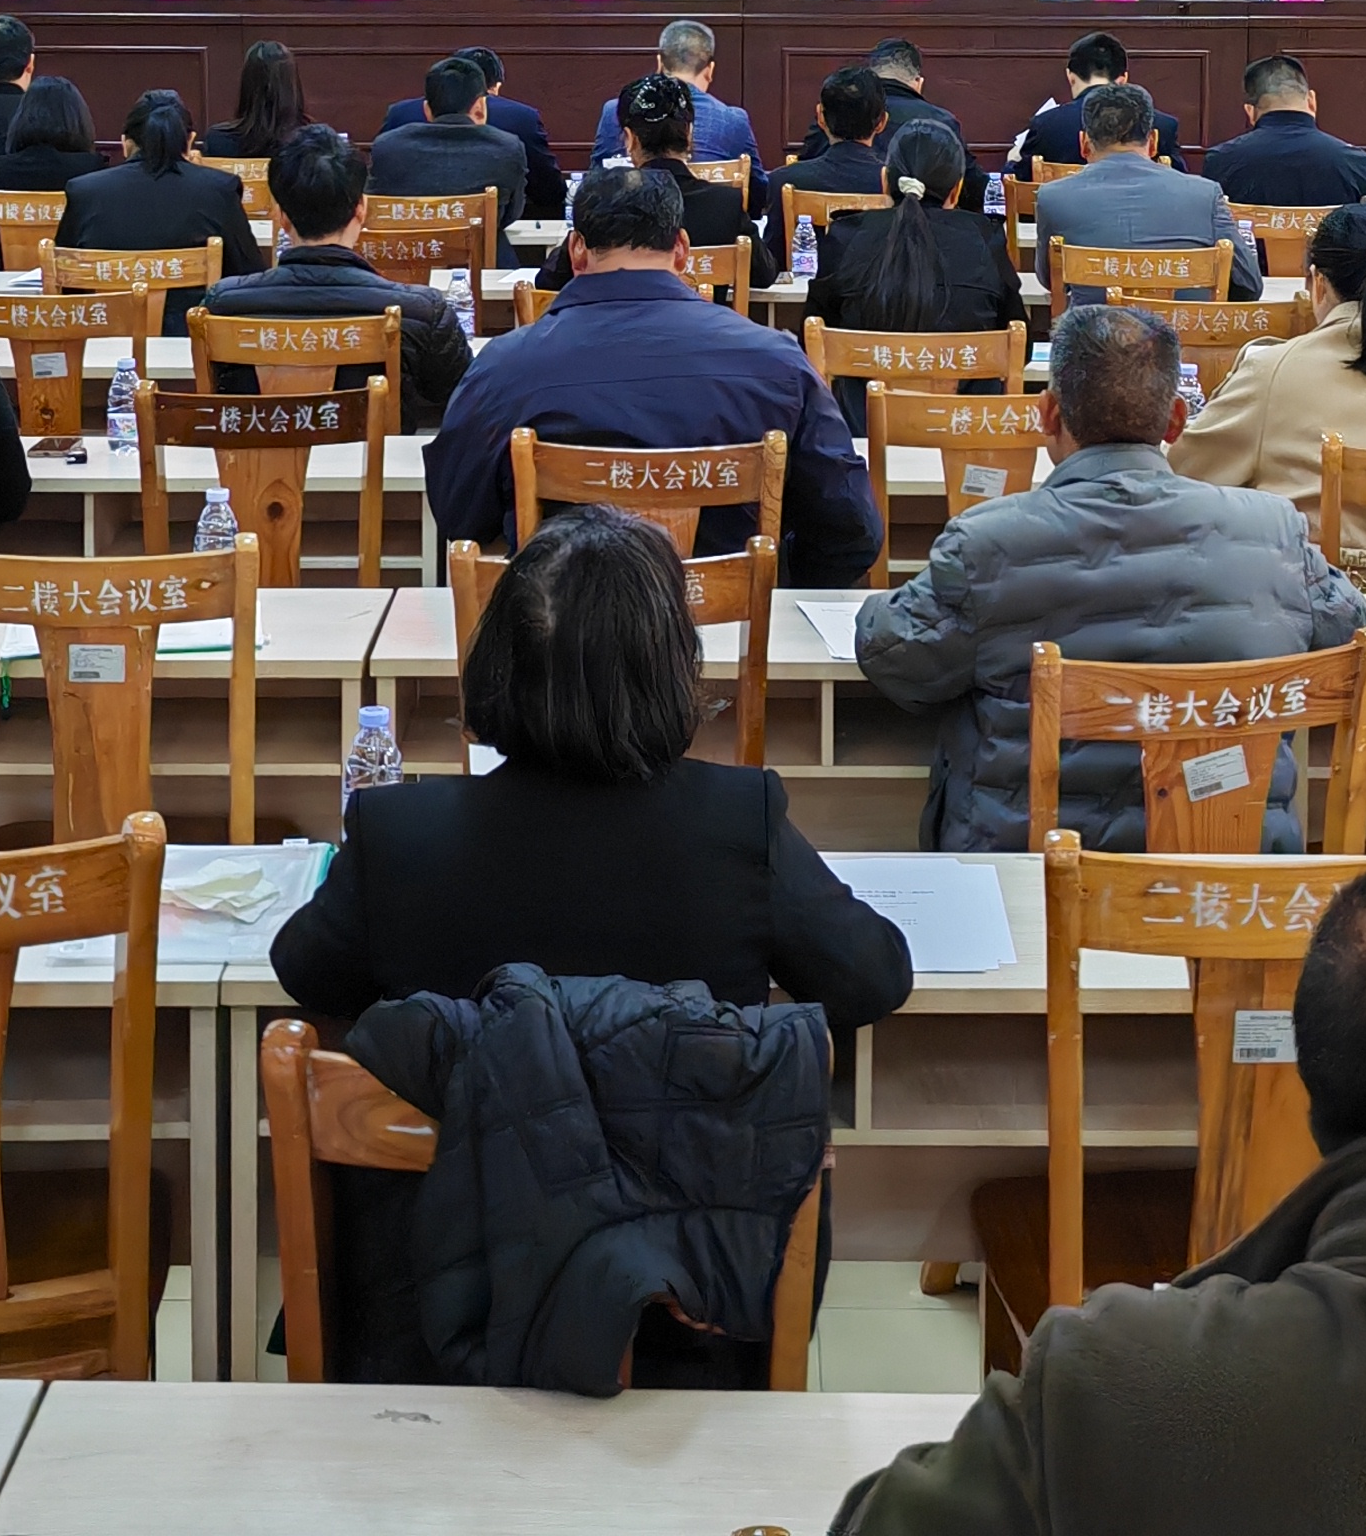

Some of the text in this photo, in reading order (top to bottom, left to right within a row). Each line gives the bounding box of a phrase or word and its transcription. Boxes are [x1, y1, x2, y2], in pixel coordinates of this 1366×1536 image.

[376, 201, 467, 221] 二楼大会议室
[78, 257, 185, 282] 二楼大会议室
[1086, 256, 1192, 279] 二楼大会议室
[238, 325, 363, 352] 二楼大会议室
[852, 344, 979, 372] 二楼大会议室
[193, 402, 342, 433] 二楼大会议室
[584, 459, 740, 491] 二楼大会议室
[1, 573, 189, 617] 二楼大会议室
[1103, 675, 1311, 734] 二楼大会议室
